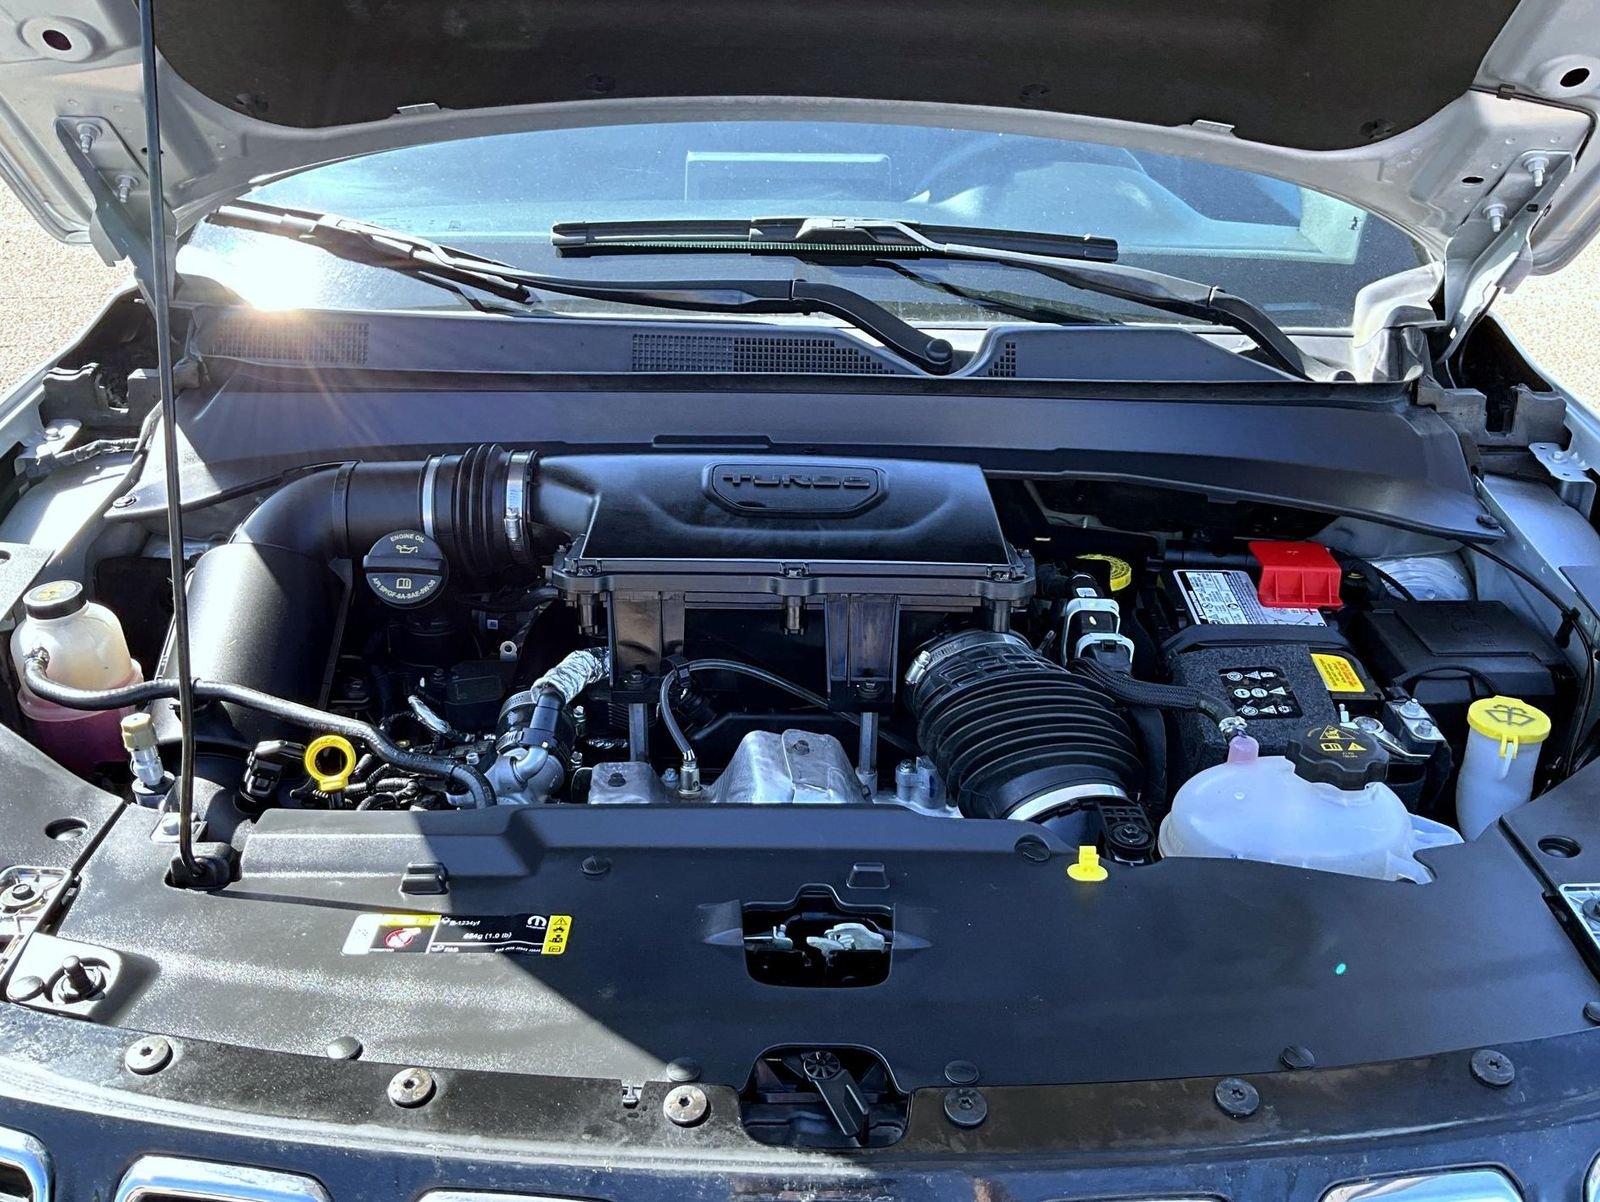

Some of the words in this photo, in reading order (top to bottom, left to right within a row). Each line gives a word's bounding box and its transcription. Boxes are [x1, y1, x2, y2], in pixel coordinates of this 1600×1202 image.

[722, 474, 871, 489] TURBO
[390, 533, 414, 542] ENGINE
[415, 534, 425, 544] OIL
[485, 932, 500, 940] (1.0
[501, 931, 512, 940] lb)
